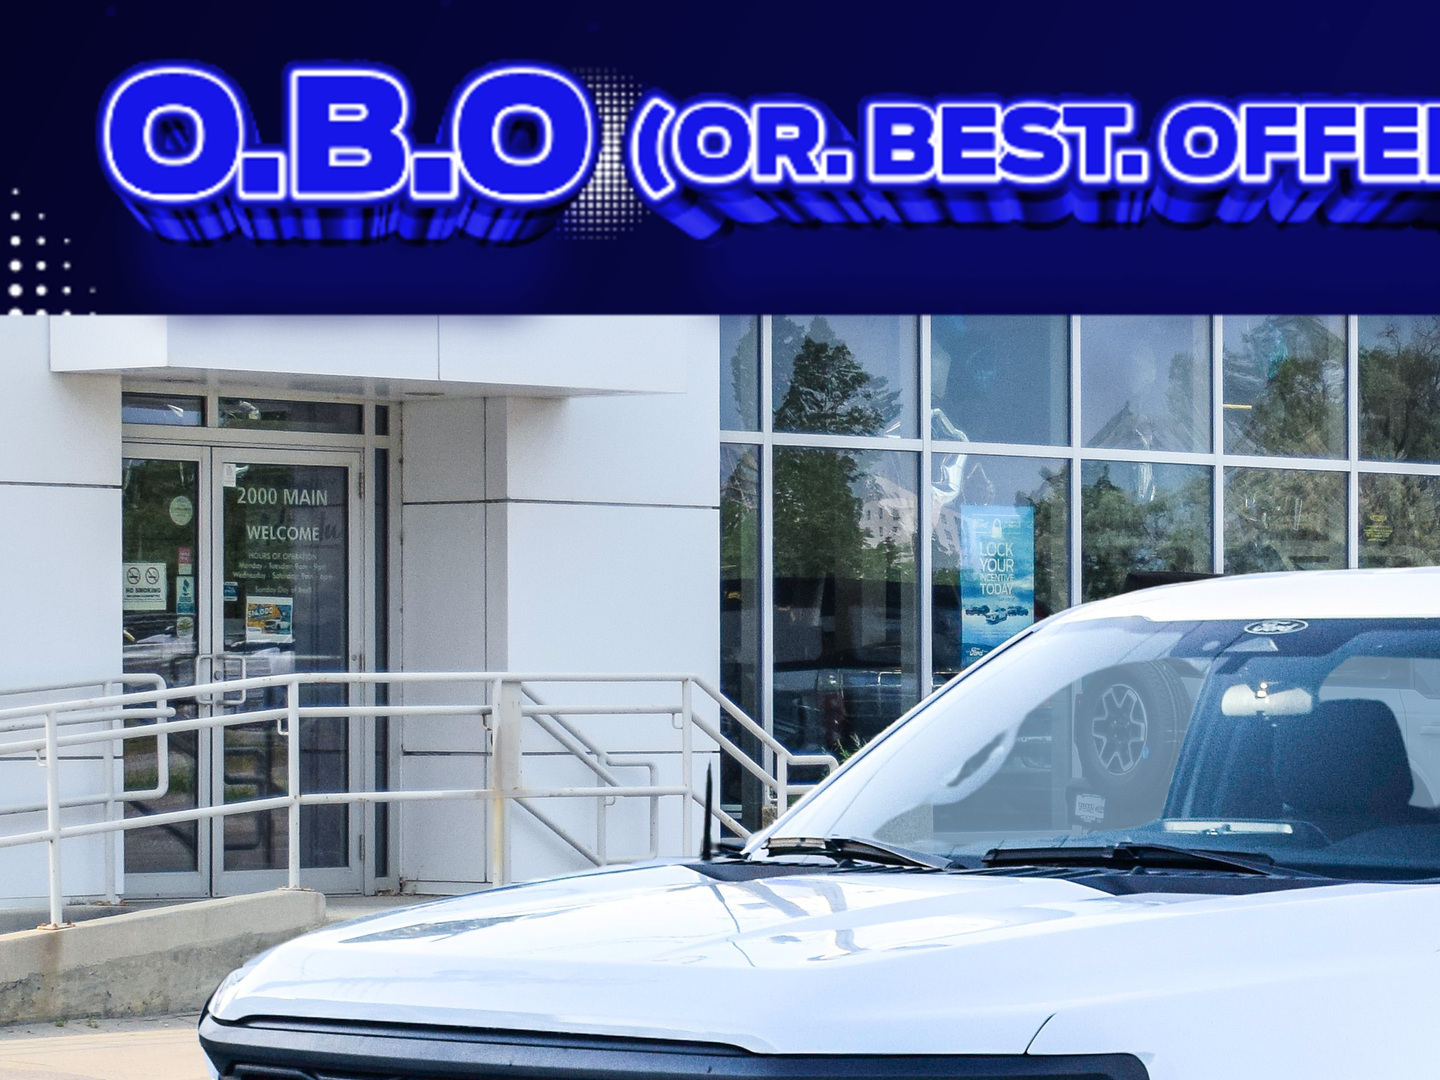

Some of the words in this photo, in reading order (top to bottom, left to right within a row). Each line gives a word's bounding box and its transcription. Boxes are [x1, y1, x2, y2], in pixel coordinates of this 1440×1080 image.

[237, 487, 278, 504] 2000
[283, 488, 328, 506] MAIN
[247, 525, 320, 541] WELCOME
[980, 542, 1014, 556] LOCK
[248, 552, 271, 560] HOURS
[980, 559, 1014, 572] YOUR
[980, 574, 1015, 582] INCENTIVE
[980, 583, 1013, 595] TODAY
